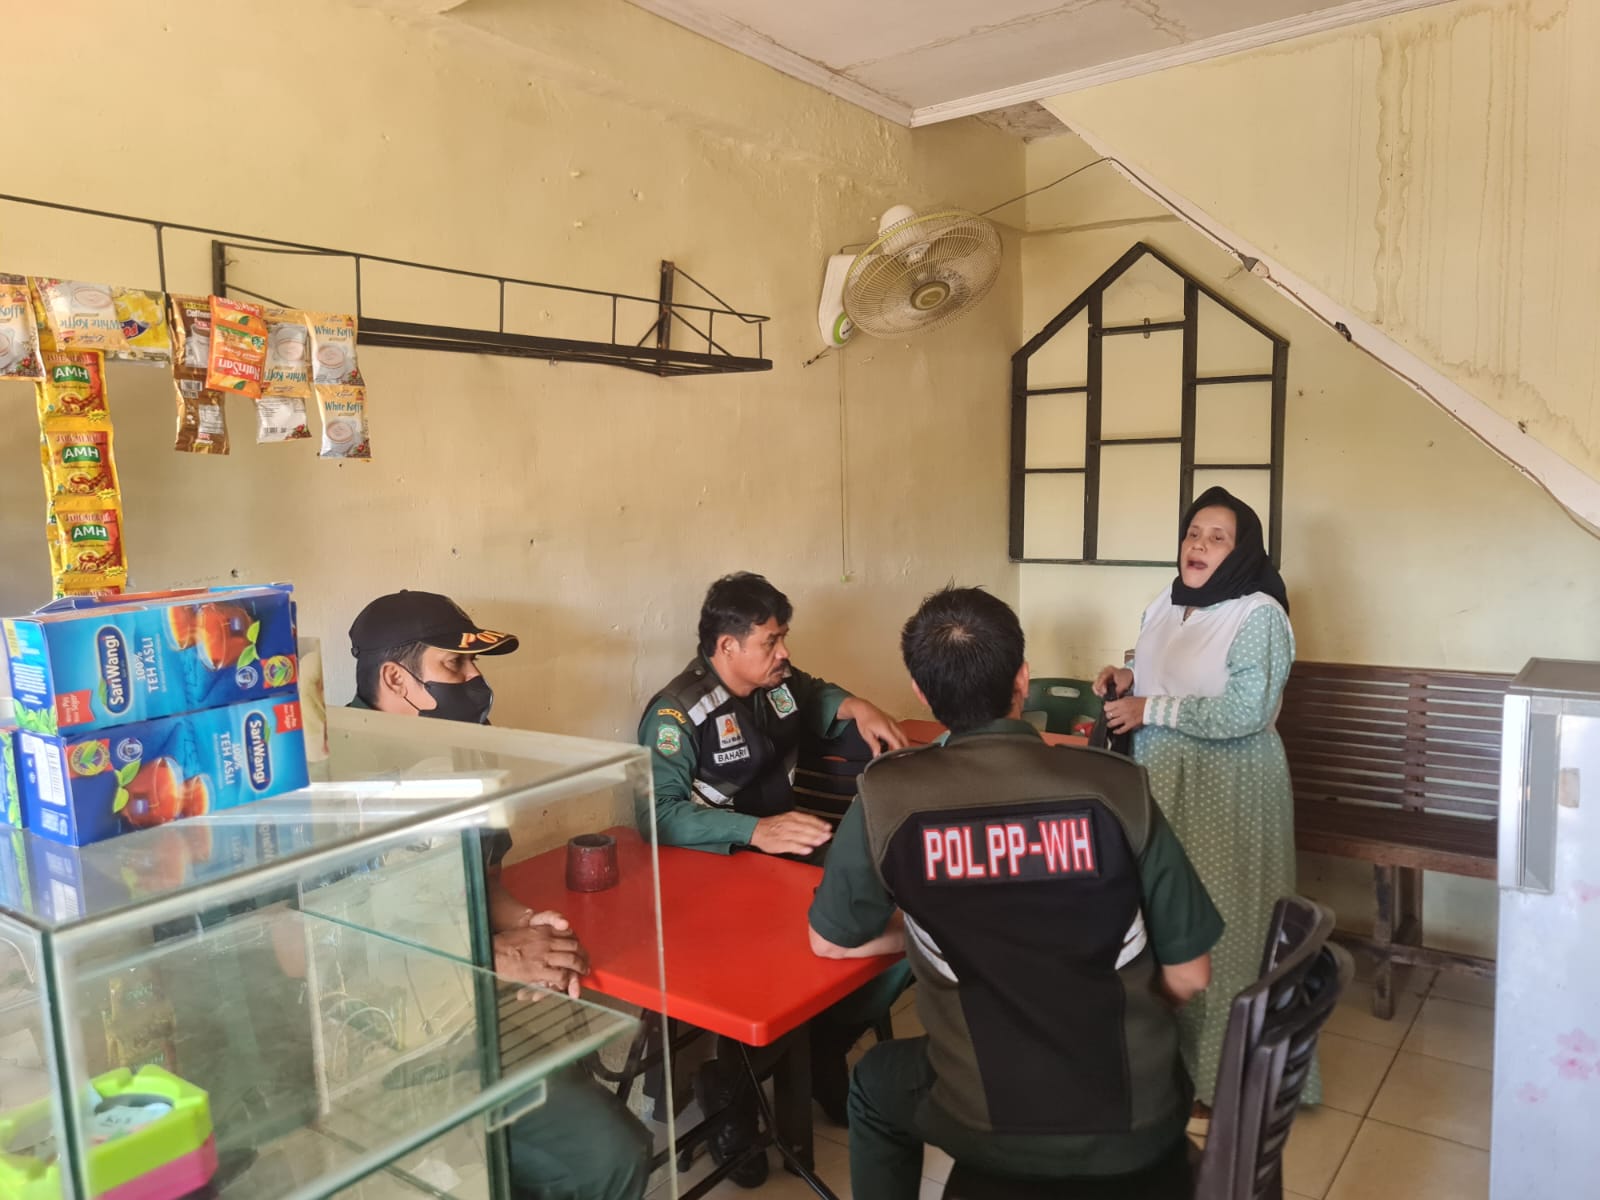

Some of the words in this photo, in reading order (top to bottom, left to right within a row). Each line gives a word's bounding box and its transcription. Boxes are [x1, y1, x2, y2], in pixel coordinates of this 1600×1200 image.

[55, 366, 89, 379] AMH
[64, 447, 99, 459] AMH
[73, 526, 107, 538] AMH
[143, 637, 155, 663] ASLI
[102, 634, 125, 706] SariWangi
[134, 652, 146, 681] 100%
[146, 667, 159, 693] TEH
[220, 732, 231, 756] TEH
[249, 719, 269, 784] SariWangi
[717, 748, 747, 762] BAHARI
[223, 760, 234, 785] ASLI
[923, 826, 986, 880] POL
[985, 817, 1094, 876] PP-WH
